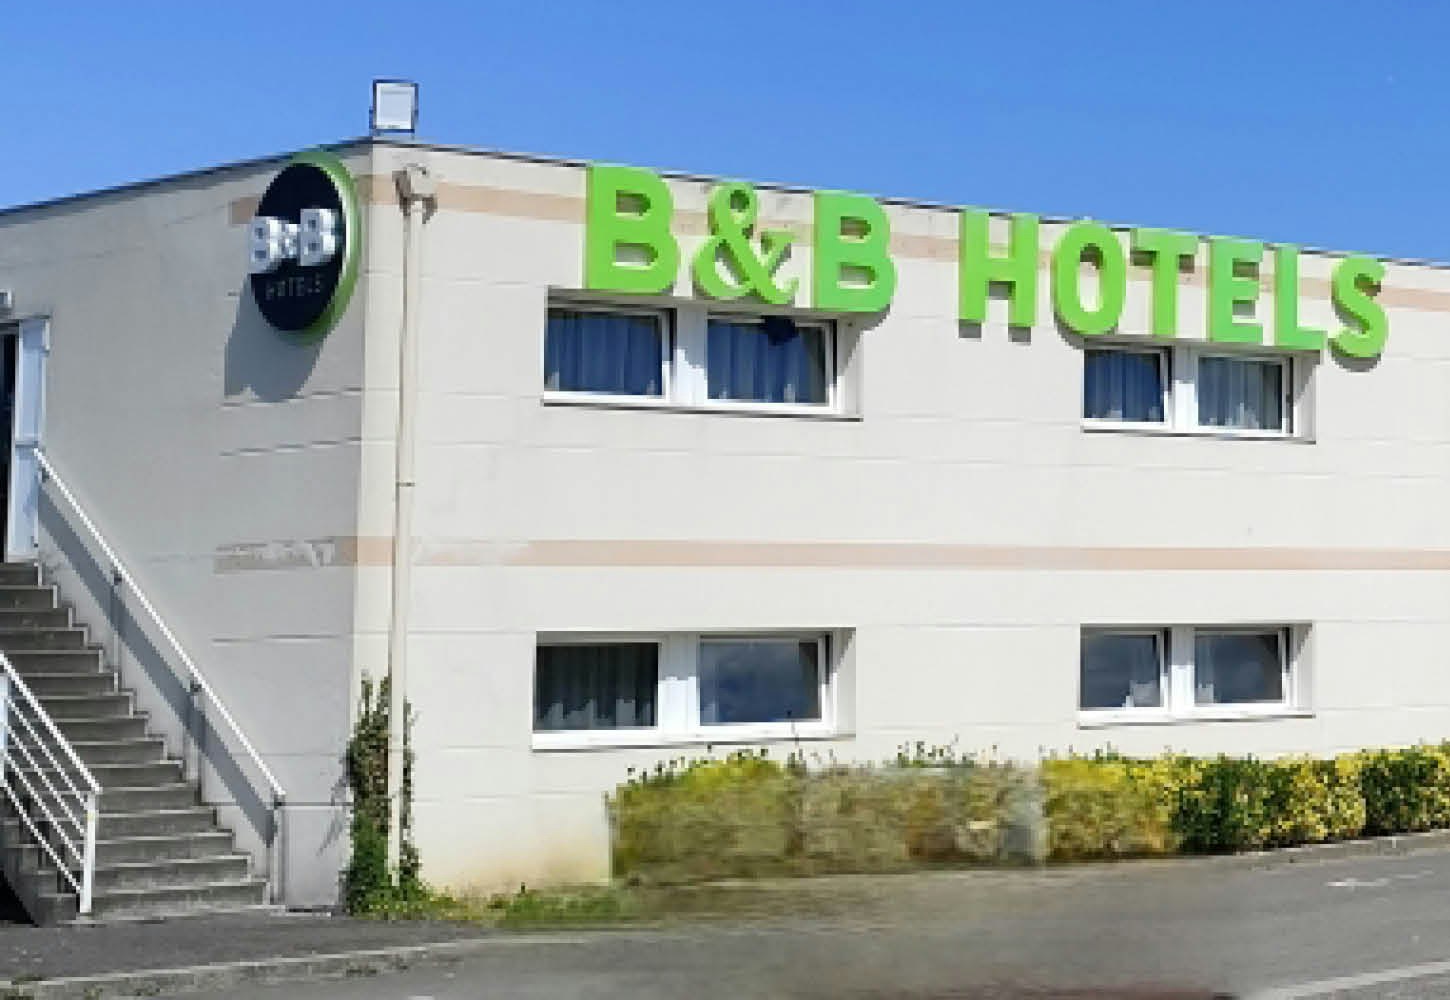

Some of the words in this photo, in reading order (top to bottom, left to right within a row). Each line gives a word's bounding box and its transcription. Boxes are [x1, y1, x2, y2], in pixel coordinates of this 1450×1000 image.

[250, 208, 336, 272] B&B
[584, 165, 896, 315] B&B
[958, 209, 1389, 359] HOTELS
